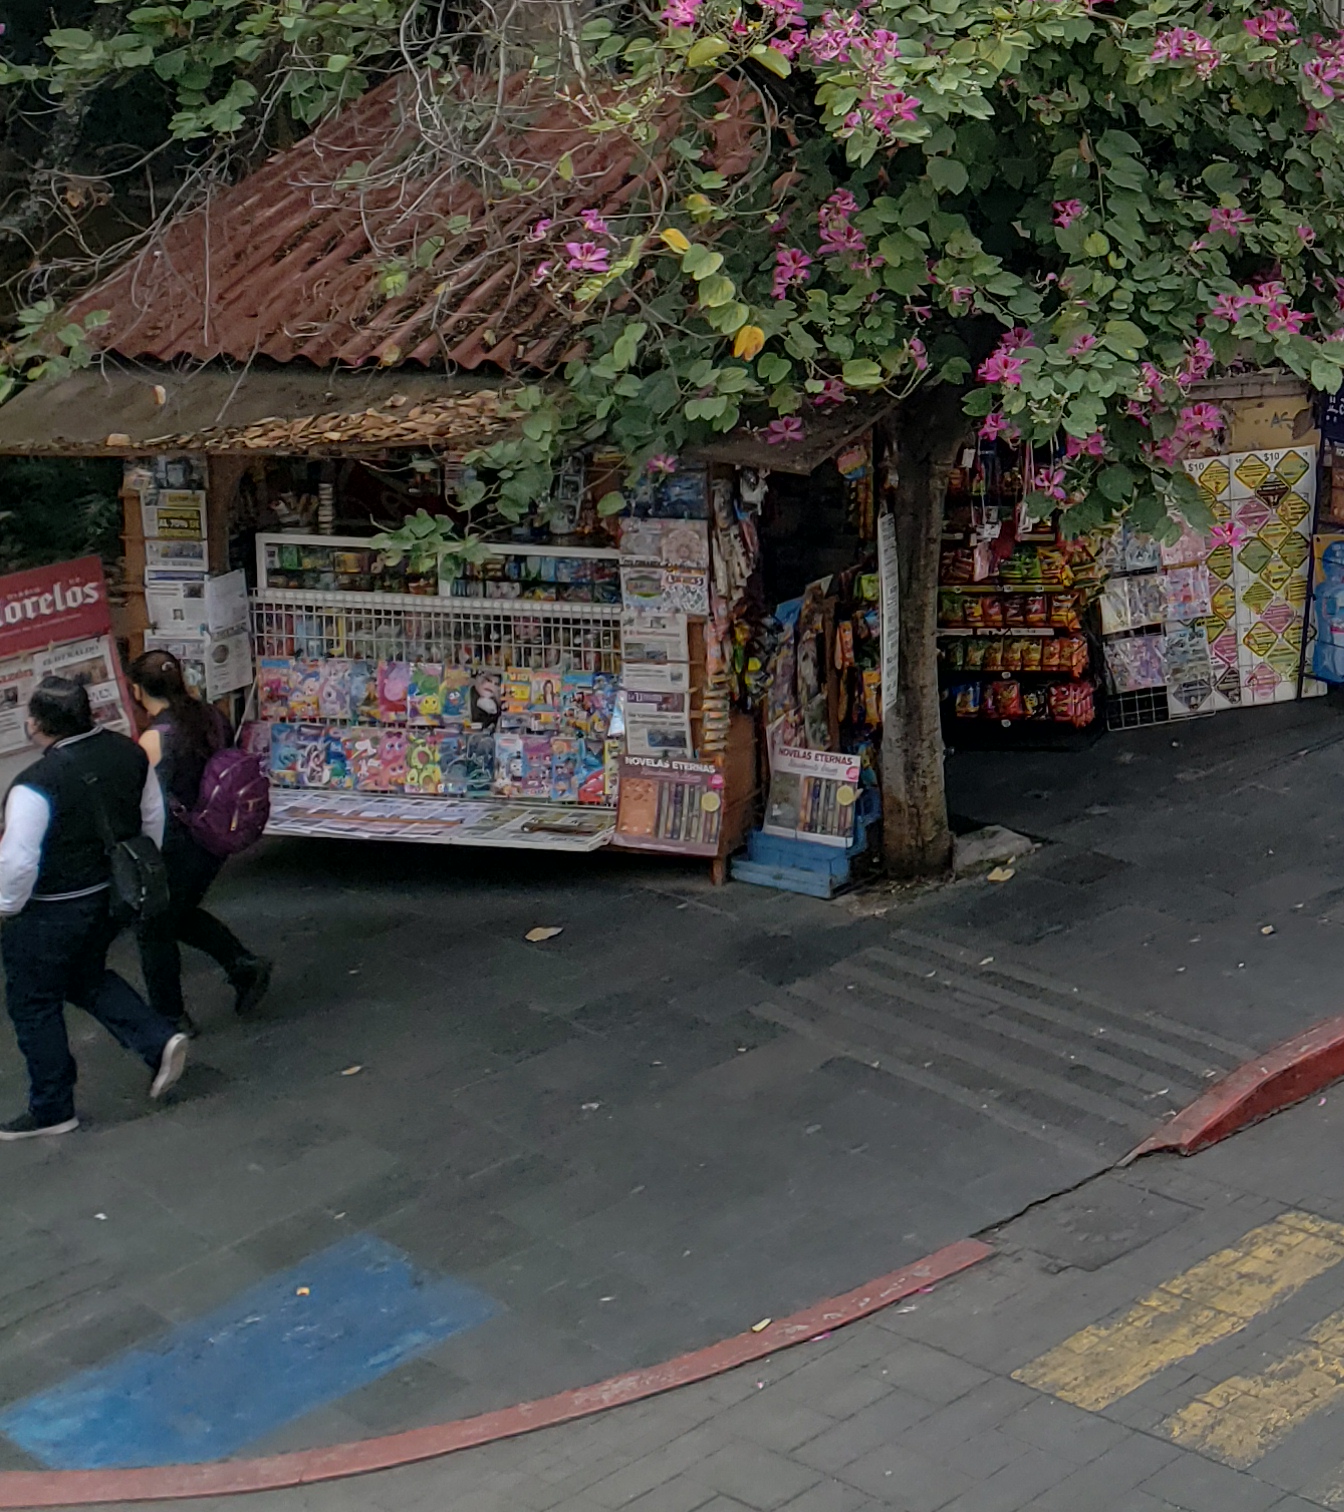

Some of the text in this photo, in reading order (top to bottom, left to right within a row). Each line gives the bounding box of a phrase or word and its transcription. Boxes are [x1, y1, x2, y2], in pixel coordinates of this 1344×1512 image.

[1263, 452, 1280, 462] $10
[1187, 462, 1205, 472] $10
[0, 582, 99, 628] orelos
[625, 756, 716, 774] NOVELAS ETERNAS
[779, 748, 853, 765] NOVELAS ETERNAS
